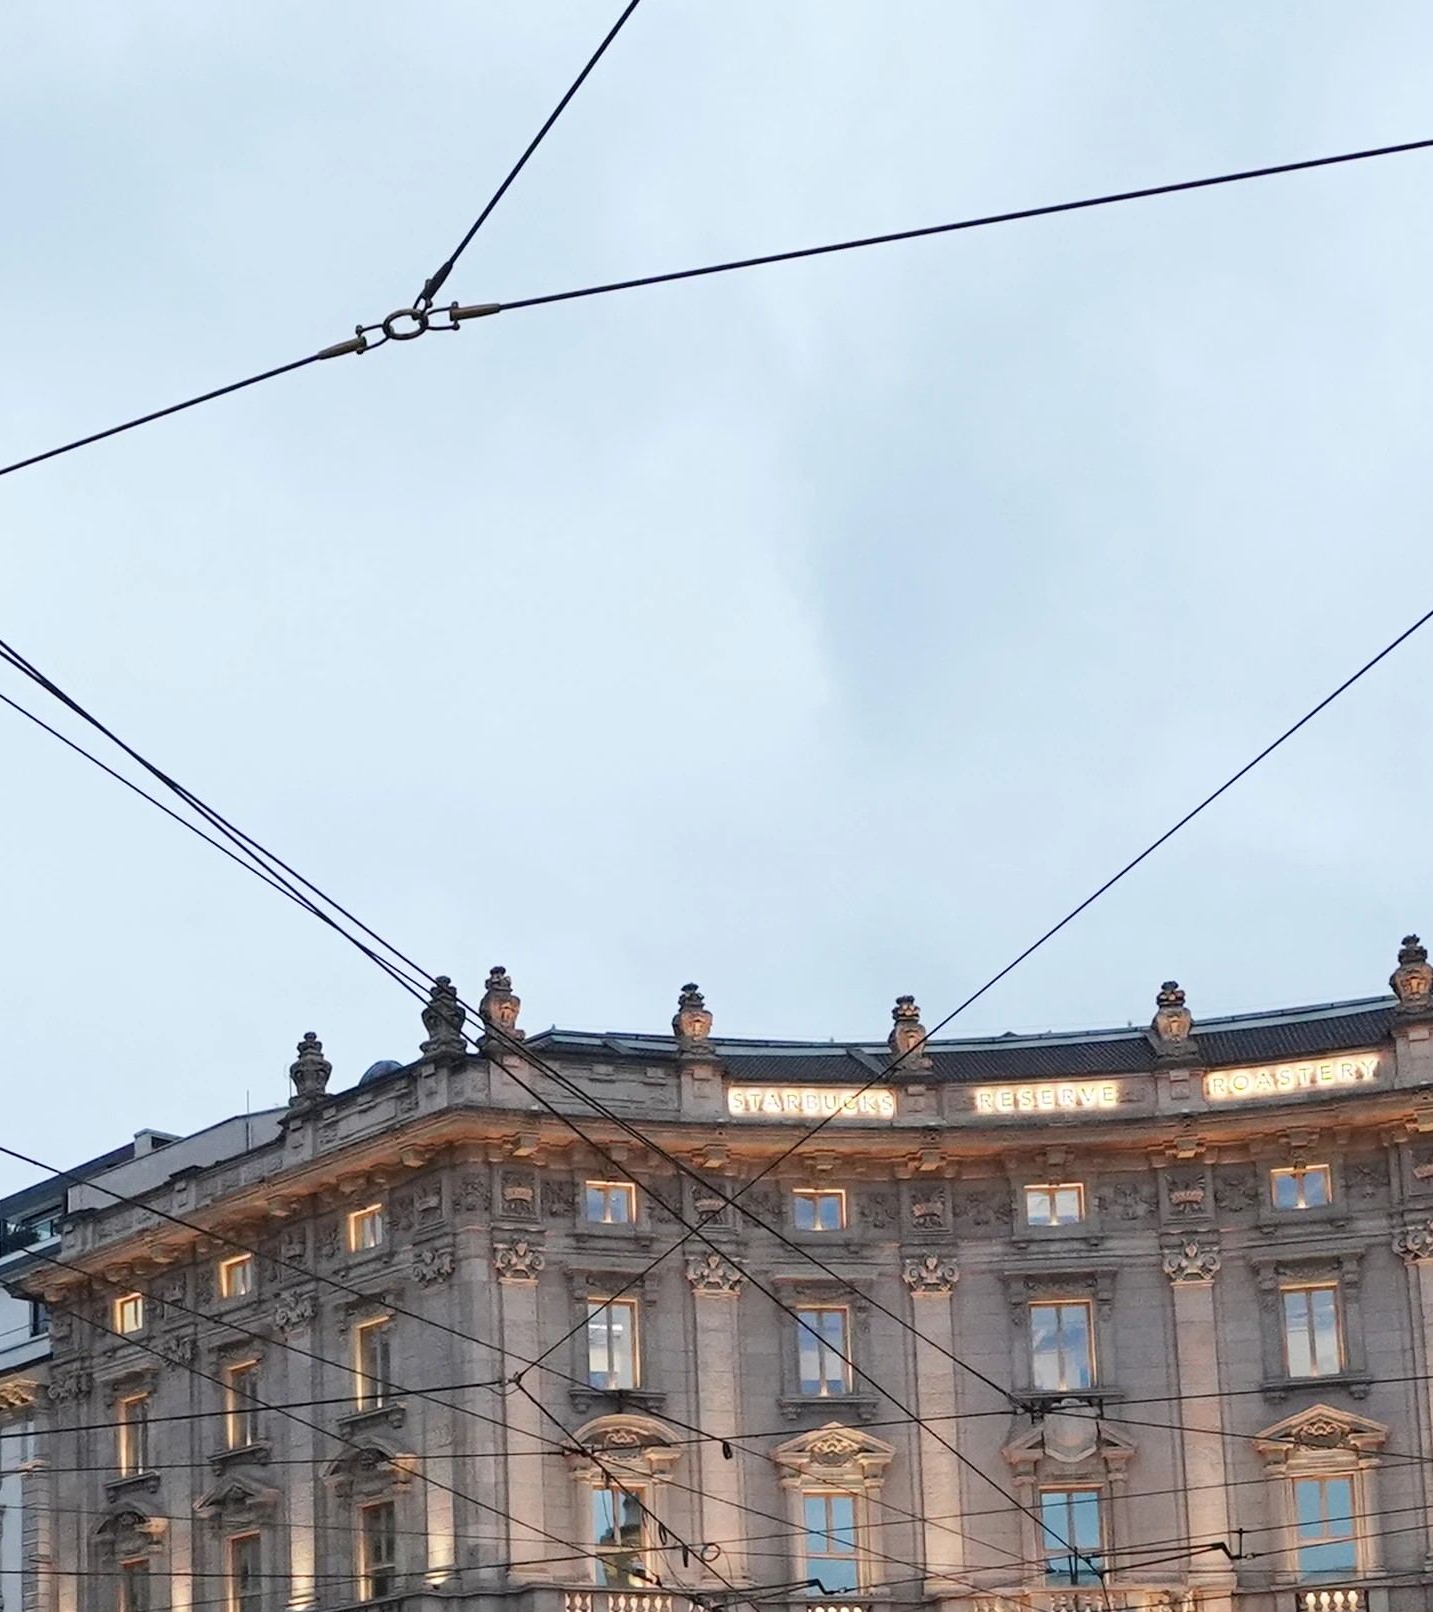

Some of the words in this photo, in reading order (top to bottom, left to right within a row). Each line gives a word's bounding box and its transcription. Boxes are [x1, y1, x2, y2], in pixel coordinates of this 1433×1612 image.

[732, 1092, 893, 1113] STARBUCKS
[979, 1086, 1115, 1108] RESERVE
[1212, 1059, 1377, 1093] ROASTERY
